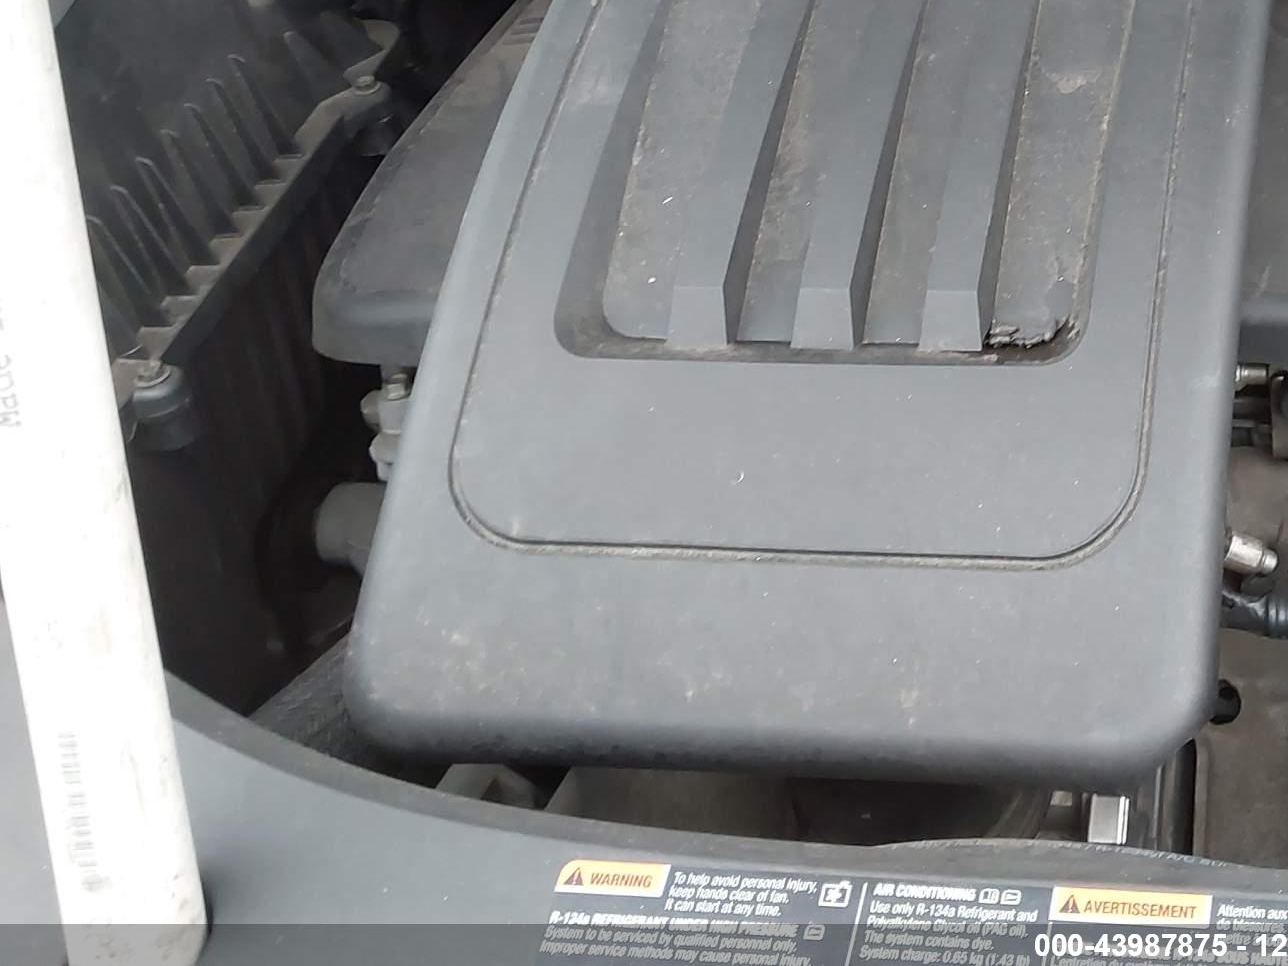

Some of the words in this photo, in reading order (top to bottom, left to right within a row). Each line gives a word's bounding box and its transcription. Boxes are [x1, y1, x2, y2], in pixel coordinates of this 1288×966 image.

[590, 872, 653, 888] WARNING
[673, 871, 687, 884] To
[687, 872, 710, 888] help
[711, 872, 741, 888] avoid
[741, 874, 787, 891] personal
[669, 885, 695, 900] keep
[695, 885, 728, 900] hands
[729, 887, 756, 901] clear
[756, 889, 768, 902] of
[664, 898, 673, 911] It
[674, 900, 694, 912] can
[695, 900, 720, 914] start
[722, 902, 733, 914] at
[733, 904, 755, 917] any
[869, 900, 891, 914] Use
[892, 902, 915, 917] only
[916, 903, 956, 918] R-134a
[957, 905, 1016, 923] Refrigerant
[1016, 909, 1039, 923] and
[1084, 899, 1198, 920] AVERTISSEMENT
[1216, 903, 1266, 920] Attention
[1266, 908, 1288, 921] aux
[543, 925, 584, 941] System
[584, 928, 597, 940] to
[597, 929, 612, 942] be
[613, 930, 658, 945] serviced
[658, 932, 673, 947] by
[673, 933, 720, 949] qualified
[719, 936, 772, 952] personnel
[864, 929, 885, 944] The
[885, 933, 925, 947] system
[925, 935, 970, 950] contains
[539, 939, 588, 956] Improper
[588, 943, 627, 958] service
